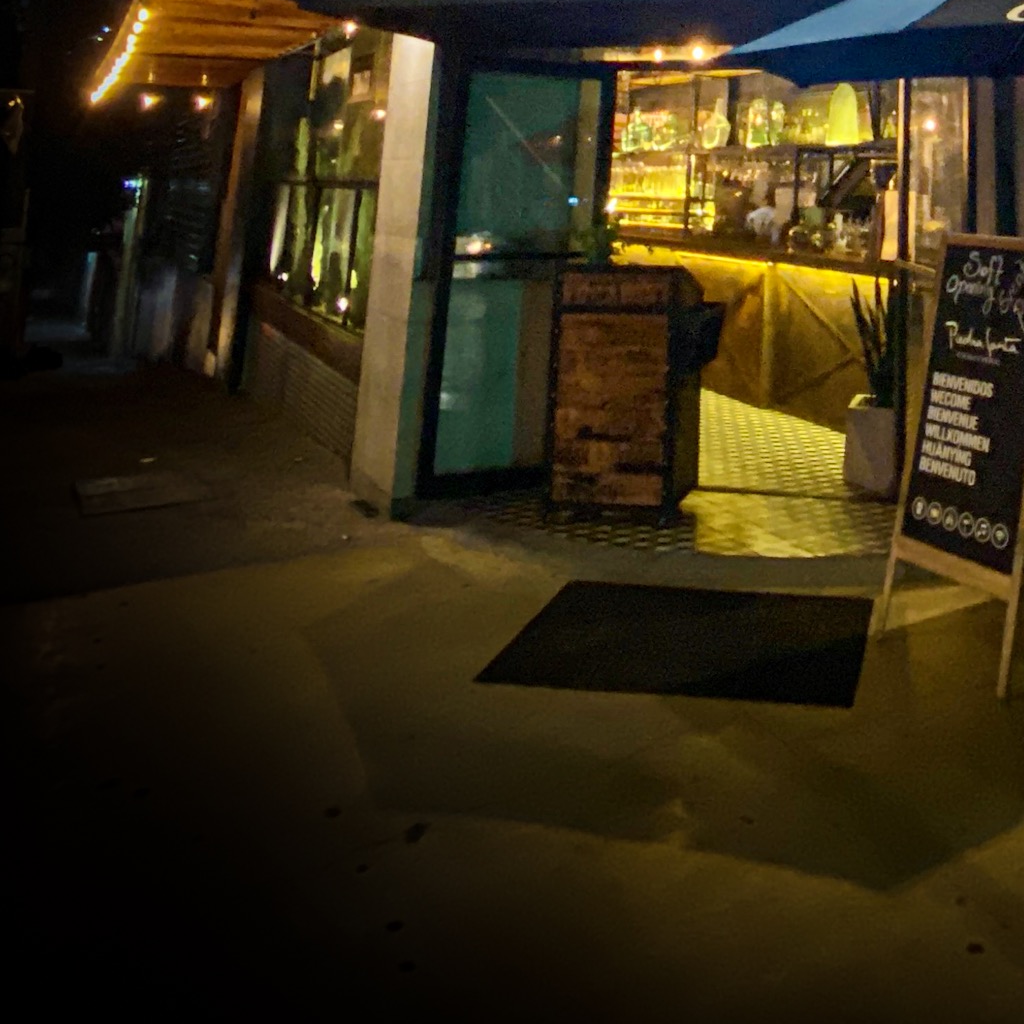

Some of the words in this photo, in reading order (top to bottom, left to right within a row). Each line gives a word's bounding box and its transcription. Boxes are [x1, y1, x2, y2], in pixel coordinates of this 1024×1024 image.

[963, 250, 1004, 287] Soft
[932, 371, 995, 398] BIENVENIDOS
[926, 405, 980, 430] BIENVENUE
[925, 422, 991, 453] WILLKOMMEN
[918, 455, 977, 487] BENVENUTO
